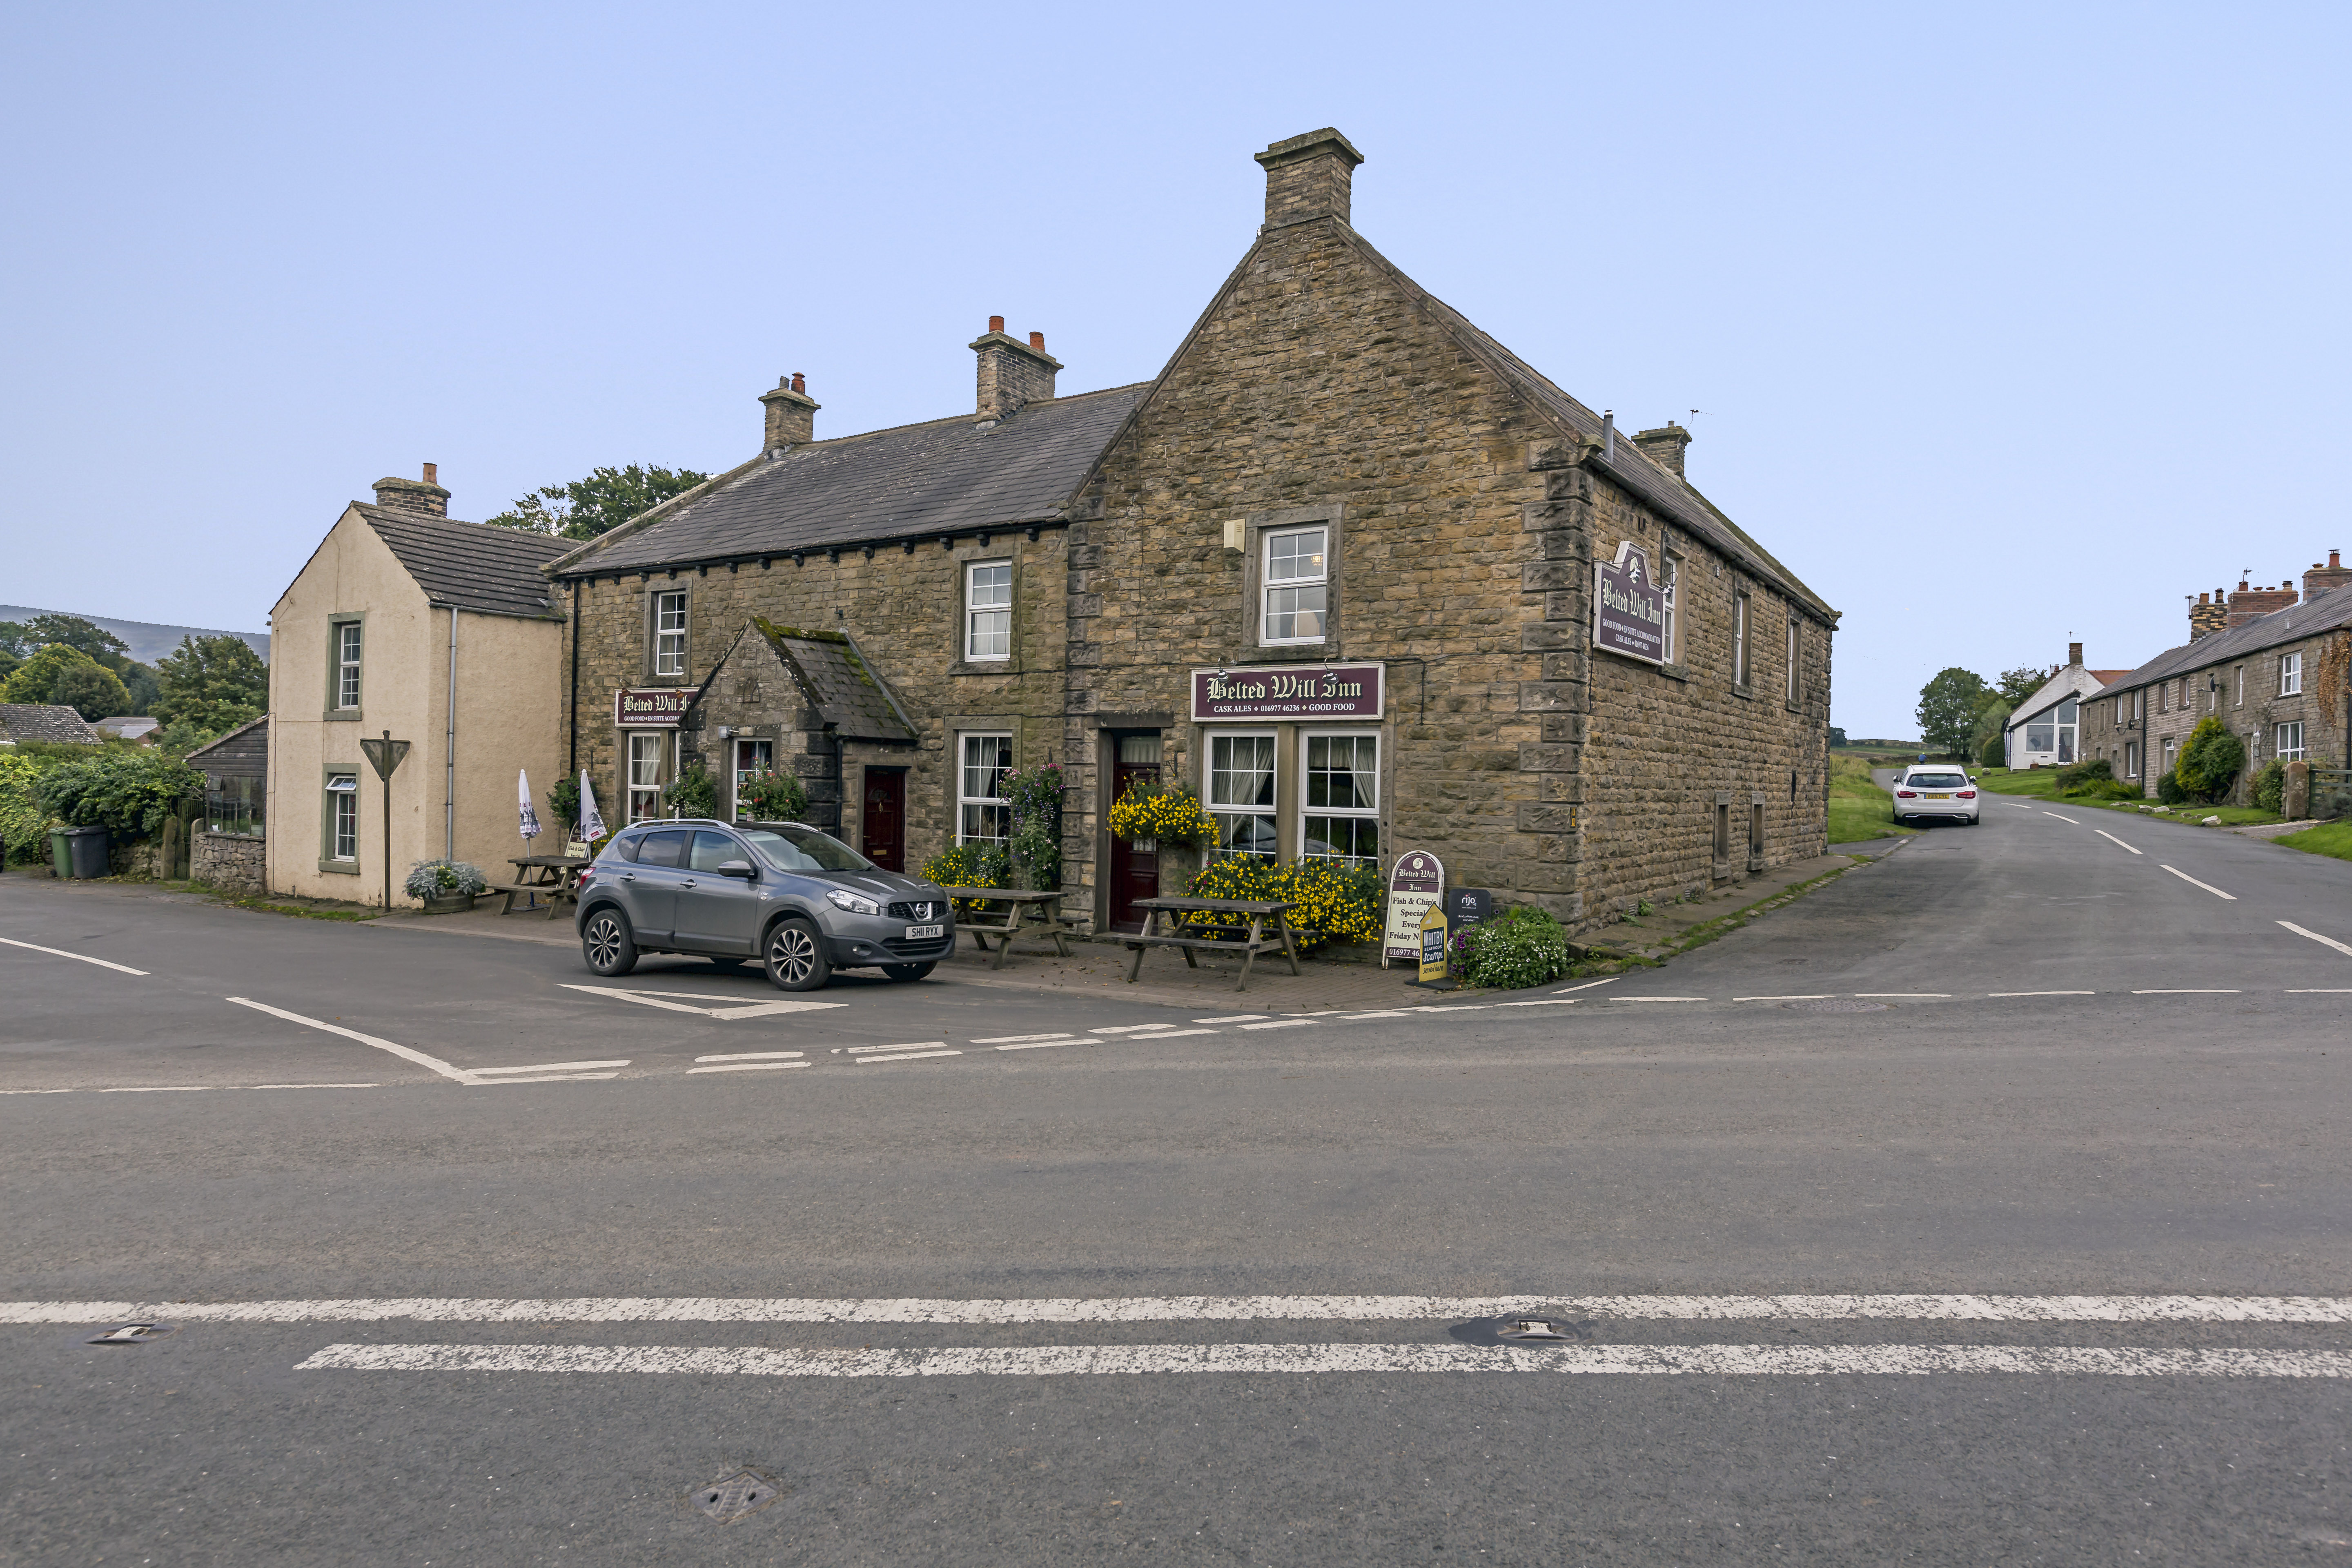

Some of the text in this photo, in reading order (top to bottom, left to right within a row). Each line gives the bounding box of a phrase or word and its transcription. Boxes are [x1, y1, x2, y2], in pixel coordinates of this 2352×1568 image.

[1603, 577, 1661, 626] Belted Will Inn
[1602, 618, 1661, 644] GOOD FOOD EN SUITE ACCOMMODATION
[1615, 634, 1624, 643] CASK
[1207, 674, 1361, 702] Belted Will Inn
[624, 696, 653, 713] Belted
[655, 695, 677, 711] Will
[1399, 869, 1436, 878] Belted Will
[1462, 896, 1475, 906] rijo
[1402, 921, 1420, 929] Every
[926, 926, 938, 936] RYX
[1389, 932, 1411, 941] Friday
[1423, 931, 1443, 947] WHITBY
